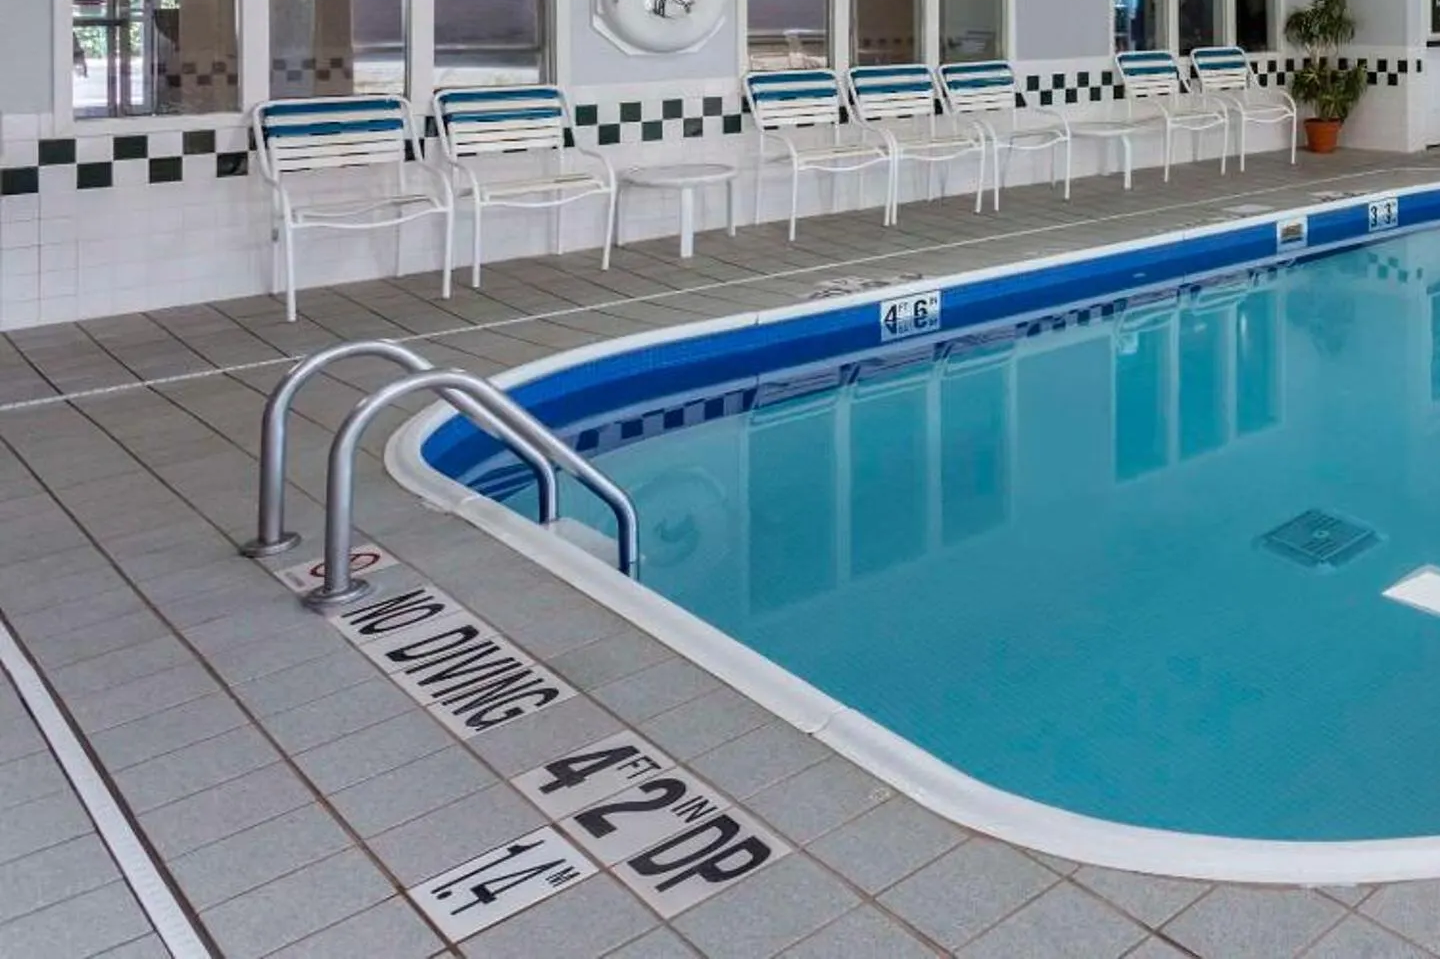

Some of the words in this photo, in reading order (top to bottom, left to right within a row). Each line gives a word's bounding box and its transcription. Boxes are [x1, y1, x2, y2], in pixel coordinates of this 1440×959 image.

[884, 303, 898, 325] 4
[913, 299, 928, 320] 6
[341, 588, 446, 637] NO
[385, 624, 561, 732] DIVING
[538, 744, 640, 795] 4
[616, 755, 661, 780] FT
[574, 777, 687, 840] 2
[671, 794, 718, 825] IN
[627, 814, 772, 894] DP
